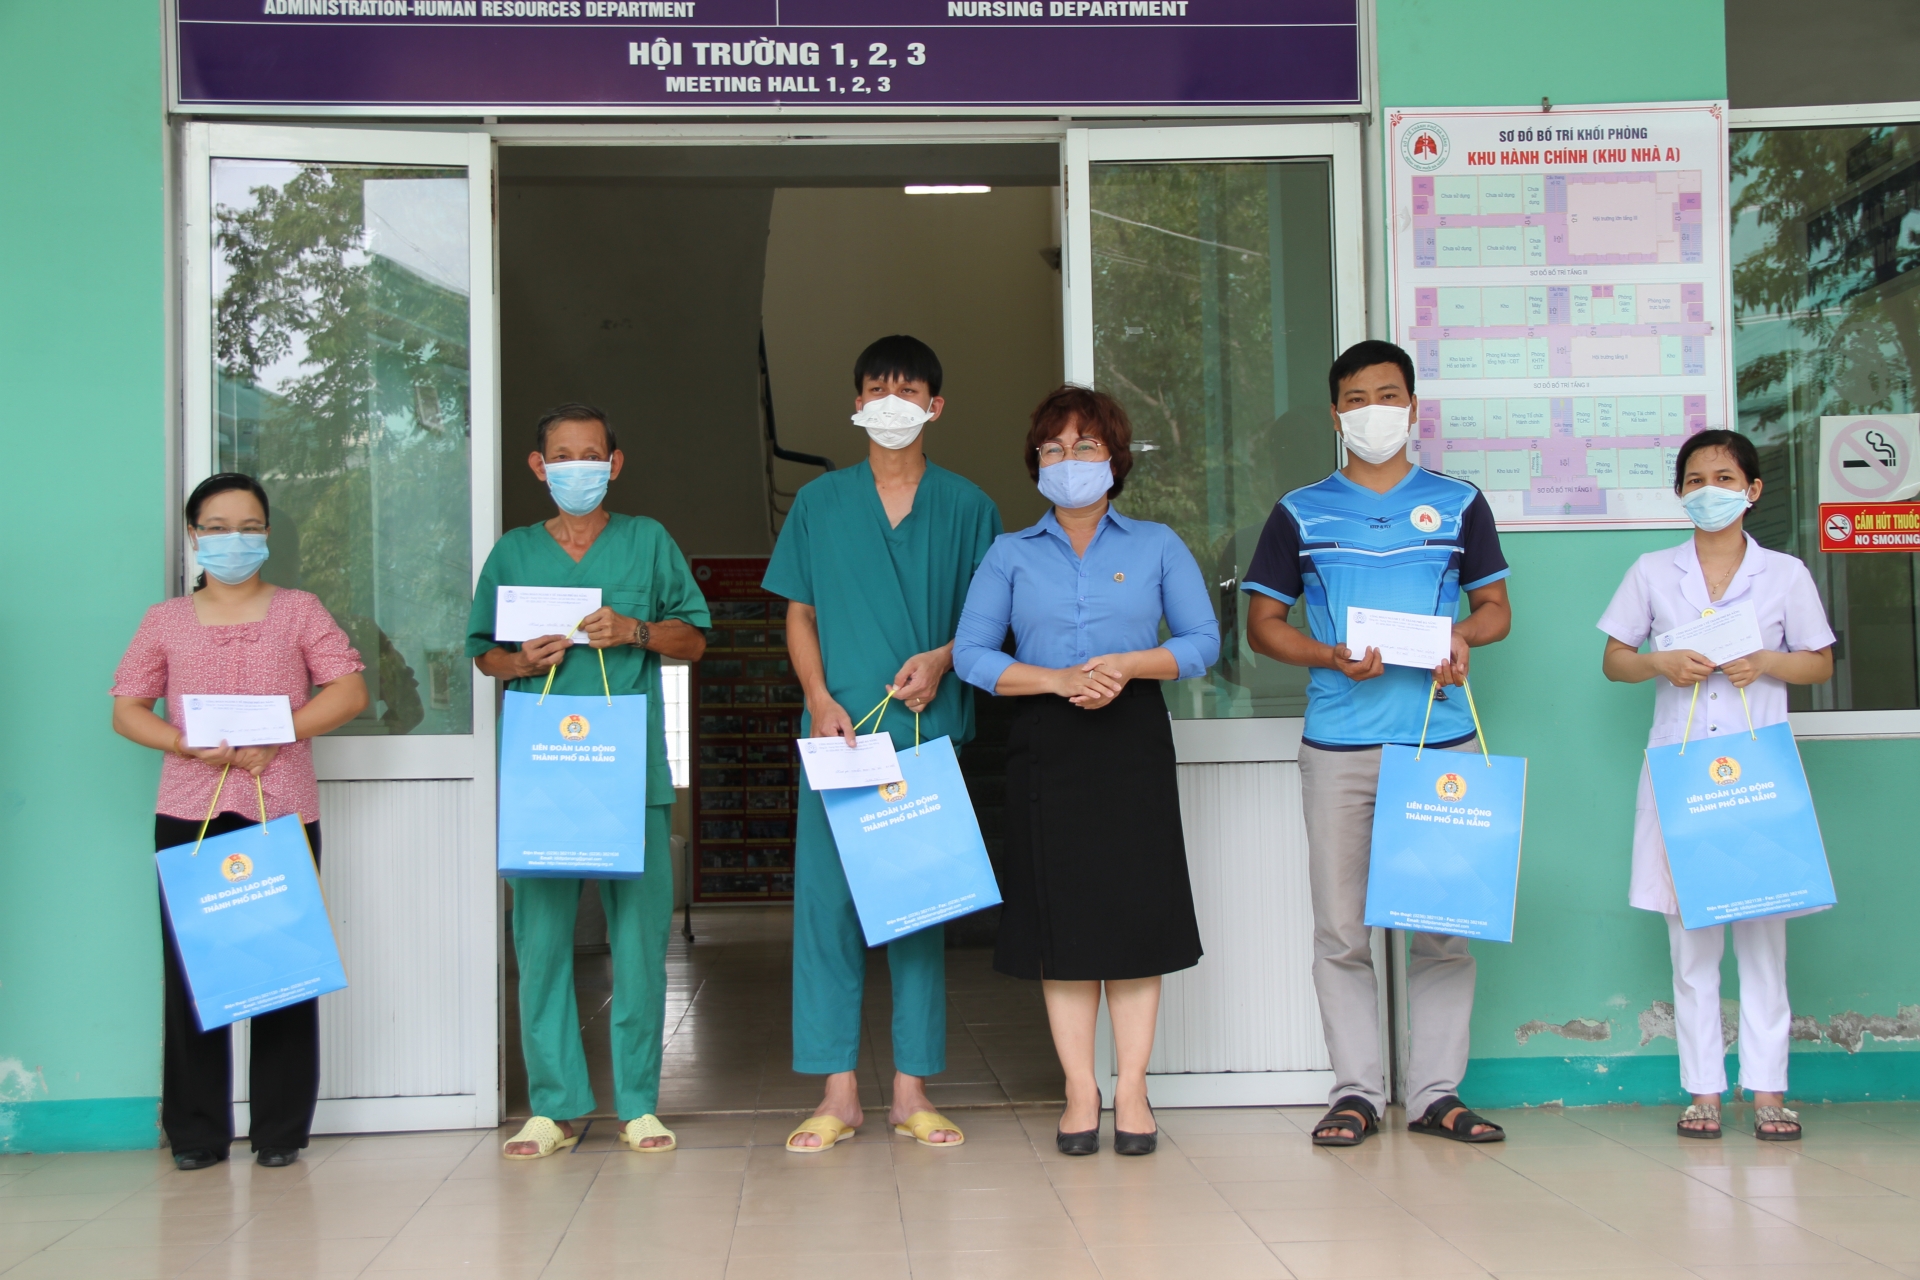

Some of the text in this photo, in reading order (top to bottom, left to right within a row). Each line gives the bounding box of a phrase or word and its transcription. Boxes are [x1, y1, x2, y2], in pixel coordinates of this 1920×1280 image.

[265, 0, 695, 17] ADMINISTRATION-HUMAN RESOURCES DEPARTMENT
[947, 1, 1189, 17] NURSING DEPARTMENT
[629, 36, 926, 70] HỘI TRƯỜNG 1, 2, 3
[666, 76, 890, 94] MEETING HALL 1, 2, 3
[1499, 125, 1648, 142] SƠ ĐỒ BỐ TRÍ KHỐI PHÒNG
[1468, 145, 1680, 165] KHU HÀNH CHÍNH (KHU NHÀ A)
[1855, 509, 1920, 530] CẤM HÚT THUỐC
[1855, 534, 1920, 544] NO SMOKING
[532, 743, 548, 751] LIÊN
[532, 753, 558, 761] THÀNH
[560, 753, 577, 761] PHỐ
[592, 752, 615, 762] NẴNG
[1686, 782, 1774, 804] LIÊN ĐOÀN LAO ĐỘNG
[1689, 791, 1776, 814] THÀNH PHỐ ĐÀ NẴNG
[860, 794, 939, 823] LIÊN ĐOÀN LAO ĐỘNG
[863, 804, 941, 832] THÀNH PHỐ ĐÀ NẴNG
[1406, 801, 1422, 809] LIÊN
[1424, 803, 1448, 813] ĐOÀN
[1468, 808, 1491, 816] ĐỘNG
[1406, 812, 1490, 827] THÀNH PHỐ ĐÀ NẴNG
[201, 874, 285, 904] LIÊN ĐOÀN LAO ĐỘNG
[203, 885, 288, 914] THÀNH PHỐ ĐÀ NẴNG
